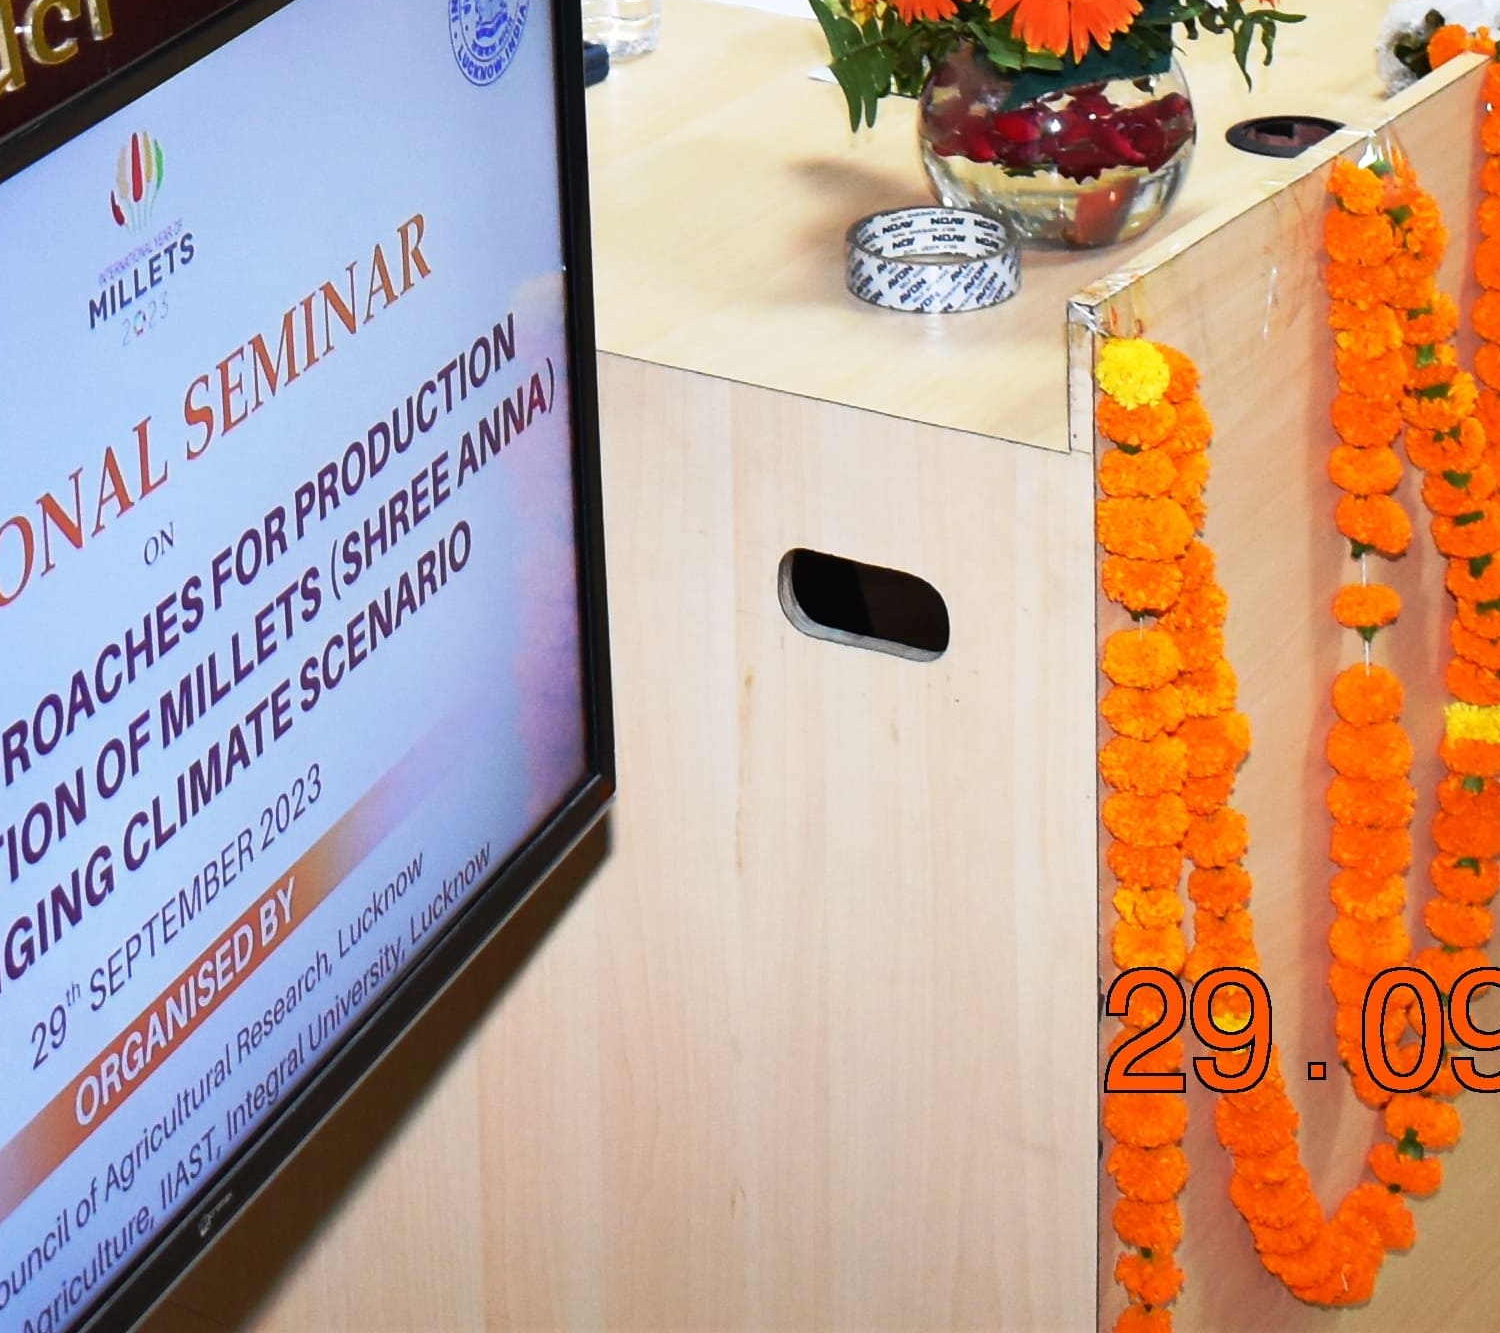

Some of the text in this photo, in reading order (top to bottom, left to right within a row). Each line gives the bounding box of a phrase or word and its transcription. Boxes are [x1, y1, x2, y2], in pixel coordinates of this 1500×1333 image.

[882, 220, 914, 235] AVON
[931, 217, 965, 226] AVON
[932, 234, 967, 243] AVON
[88, 232, 195, 330] MILLETS
[121, 290, 169, 347] 2023
[888, 265, 914, 289] AVON
[900, 277, 927, 304] AVON
[963, 261, 988, 294] AVON
[183, 212, 432, 461] SEMINAR
[211, 505, 287, 610] FOR
[295, 313, 516, 541] PRODUCTION
[96, 710, 151, 800] OF
[159, 566, 322, 749] MILLETS
[331, 451, 452, 601] (SHREE
[457, 358, 555, 488] ANNA)
[144, 522, 174, 566] ON
[123, 679, 293, 871] CLIMATE
[299, 520, 472, 713] SCENARIO
[32, 763, 322, 1071] 29th SEPTEMBER 2023
[74, 877, 296, 1127] ORGANISED BY
[227, 1032, 305, 1141] Integral
[308, 934, 407, 1052] University,
[410, 841, 491, 946] Lucknow
[75, 1177, 99, 1229] of
[104, 1043, 232, 1203] Agricultural
[236, 950, 333, 1064] Research,
[338, 852, 424, 959] Lucknow
